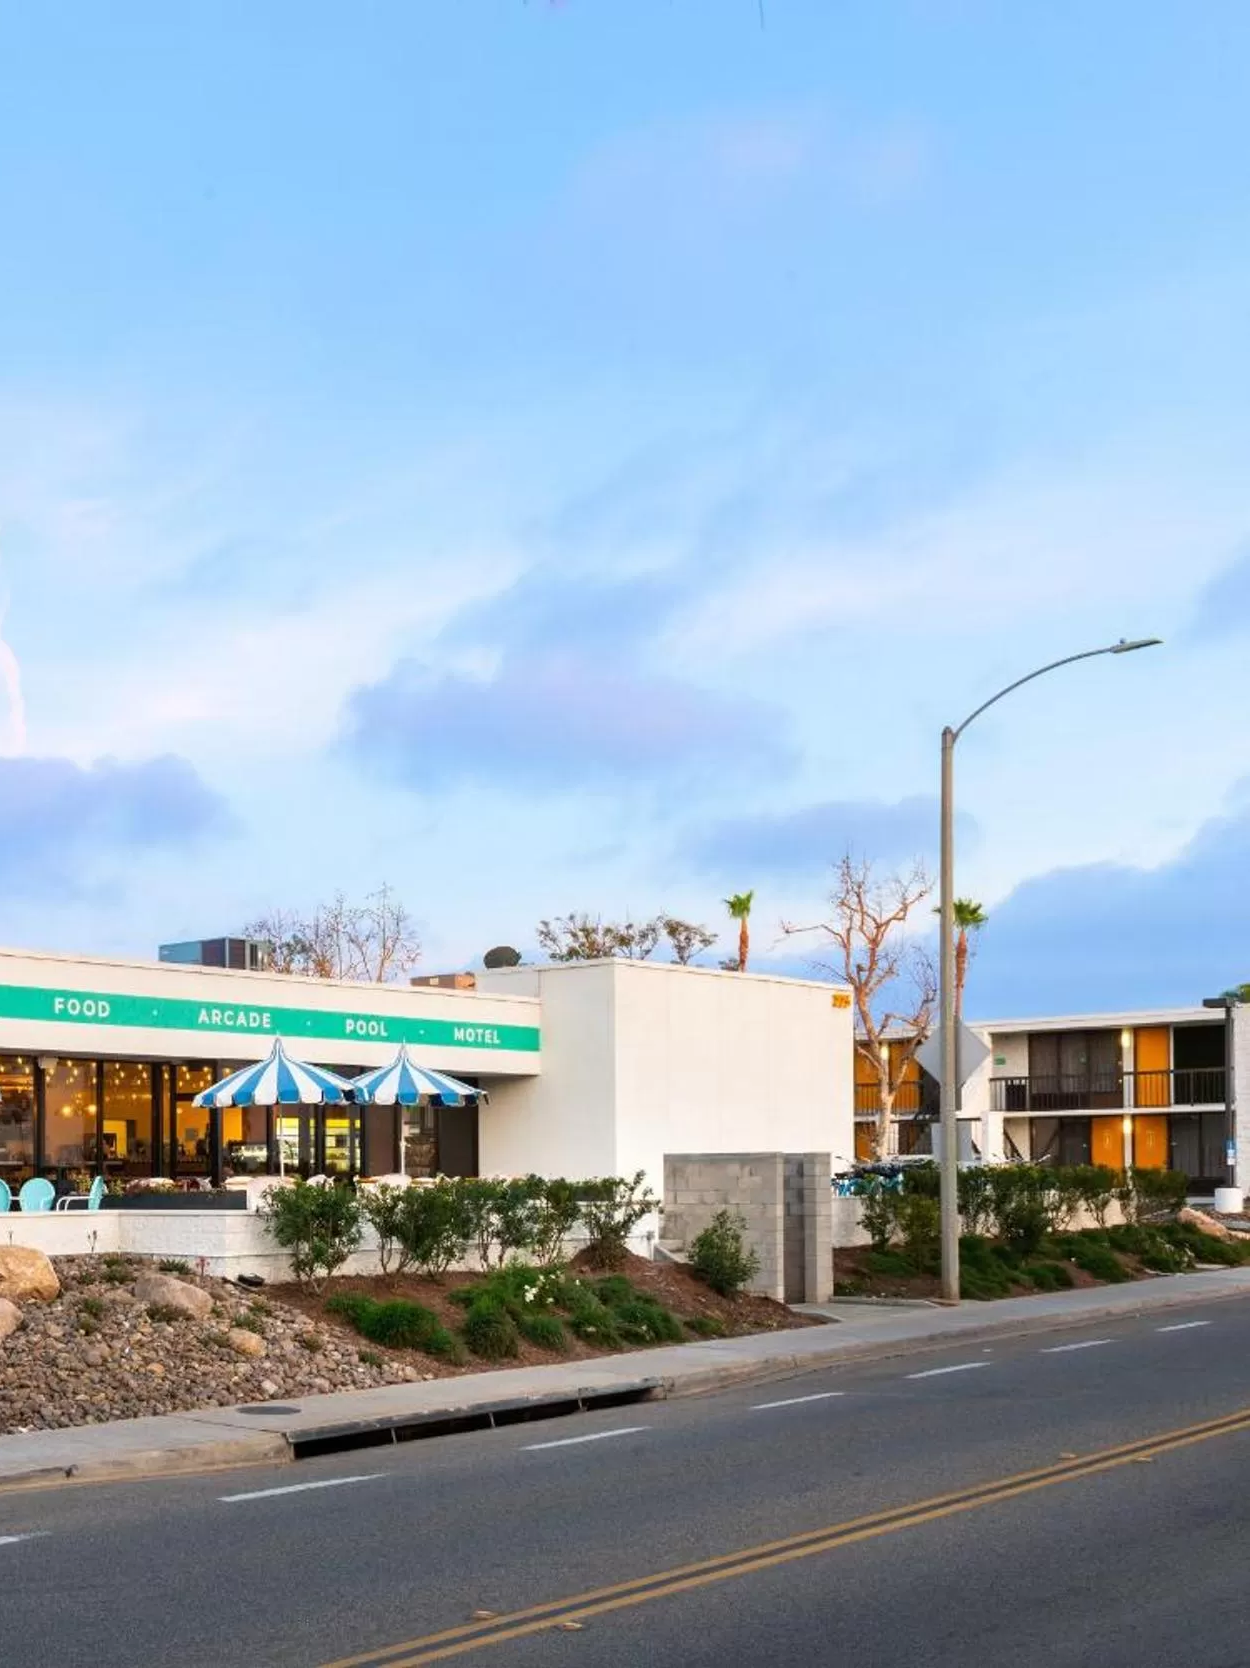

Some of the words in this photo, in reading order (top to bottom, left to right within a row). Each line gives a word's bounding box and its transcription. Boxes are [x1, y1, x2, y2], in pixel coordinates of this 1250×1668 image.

[53, 997, 111, 1017] FOOD
[197, 1008, 272, 1028] ARCADE
[345, 1019, 388, 1037] POOL
[453, 1027, 501, 1044] MOTEL
